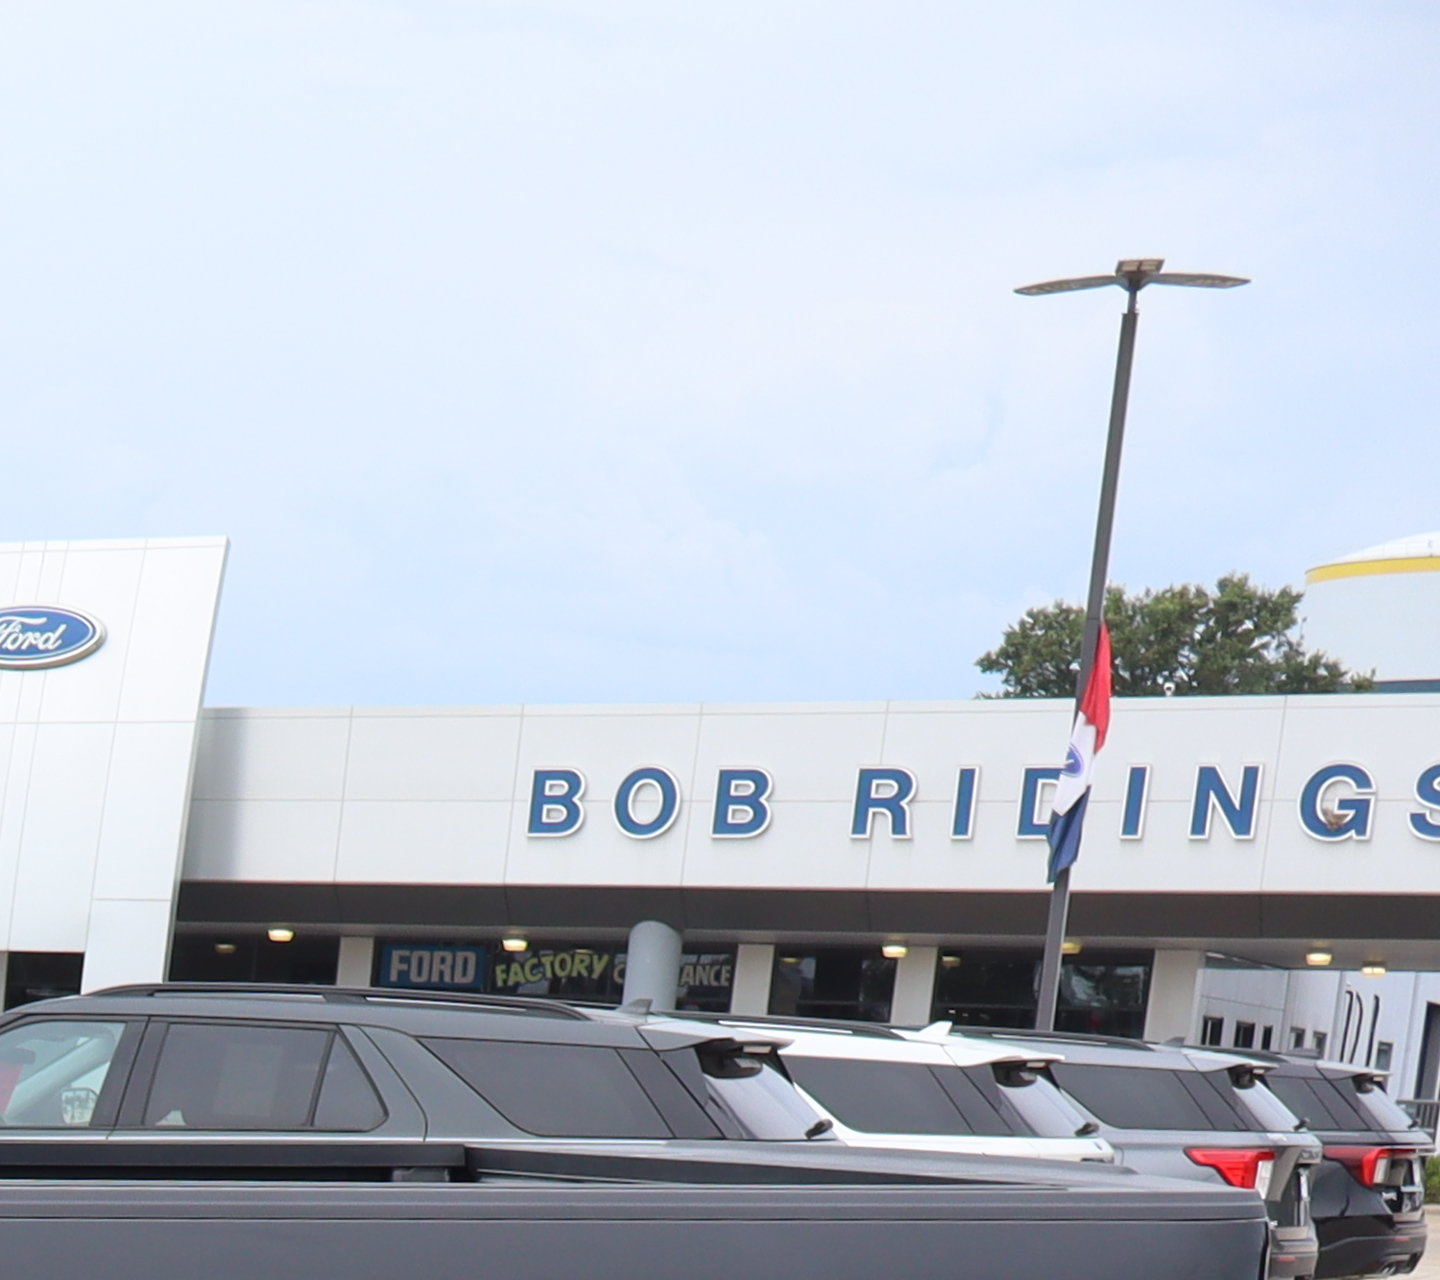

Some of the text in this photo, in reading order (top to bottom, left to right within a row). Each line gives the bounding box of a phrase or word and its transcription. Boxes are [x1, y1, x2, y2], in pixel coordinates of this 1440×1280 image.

[527, 766, 774, 840] BOB
[389, 950, 477, 984] FORD
[495, 951, 610, 987] FACTORY
